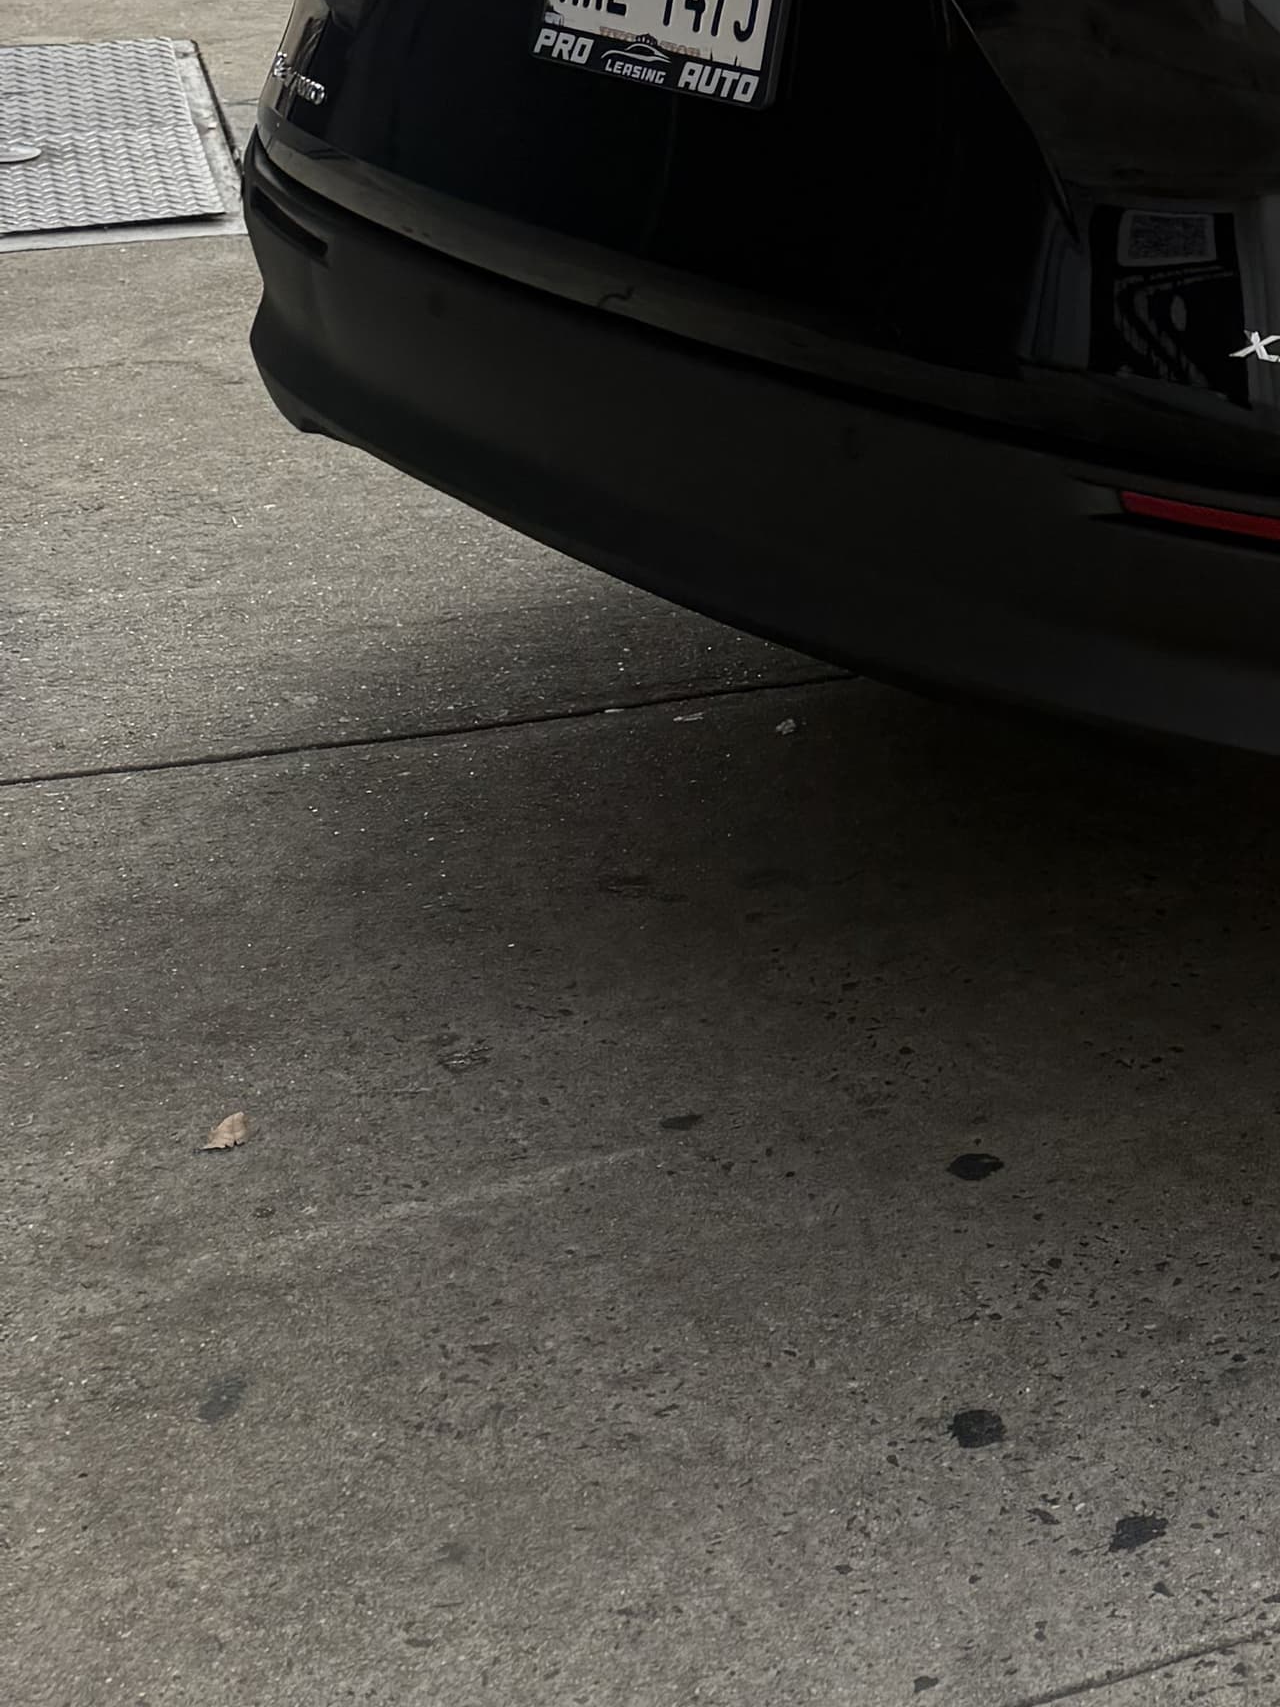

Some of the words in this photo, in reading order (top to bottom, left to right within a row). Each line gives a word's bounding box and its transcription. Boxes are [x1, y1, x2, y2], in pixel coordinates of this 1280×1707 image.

[533, 28, 595, 65] PRO
[605, 59, 667, 85] LEASING
[678, 61, 760, 103] AUTO
